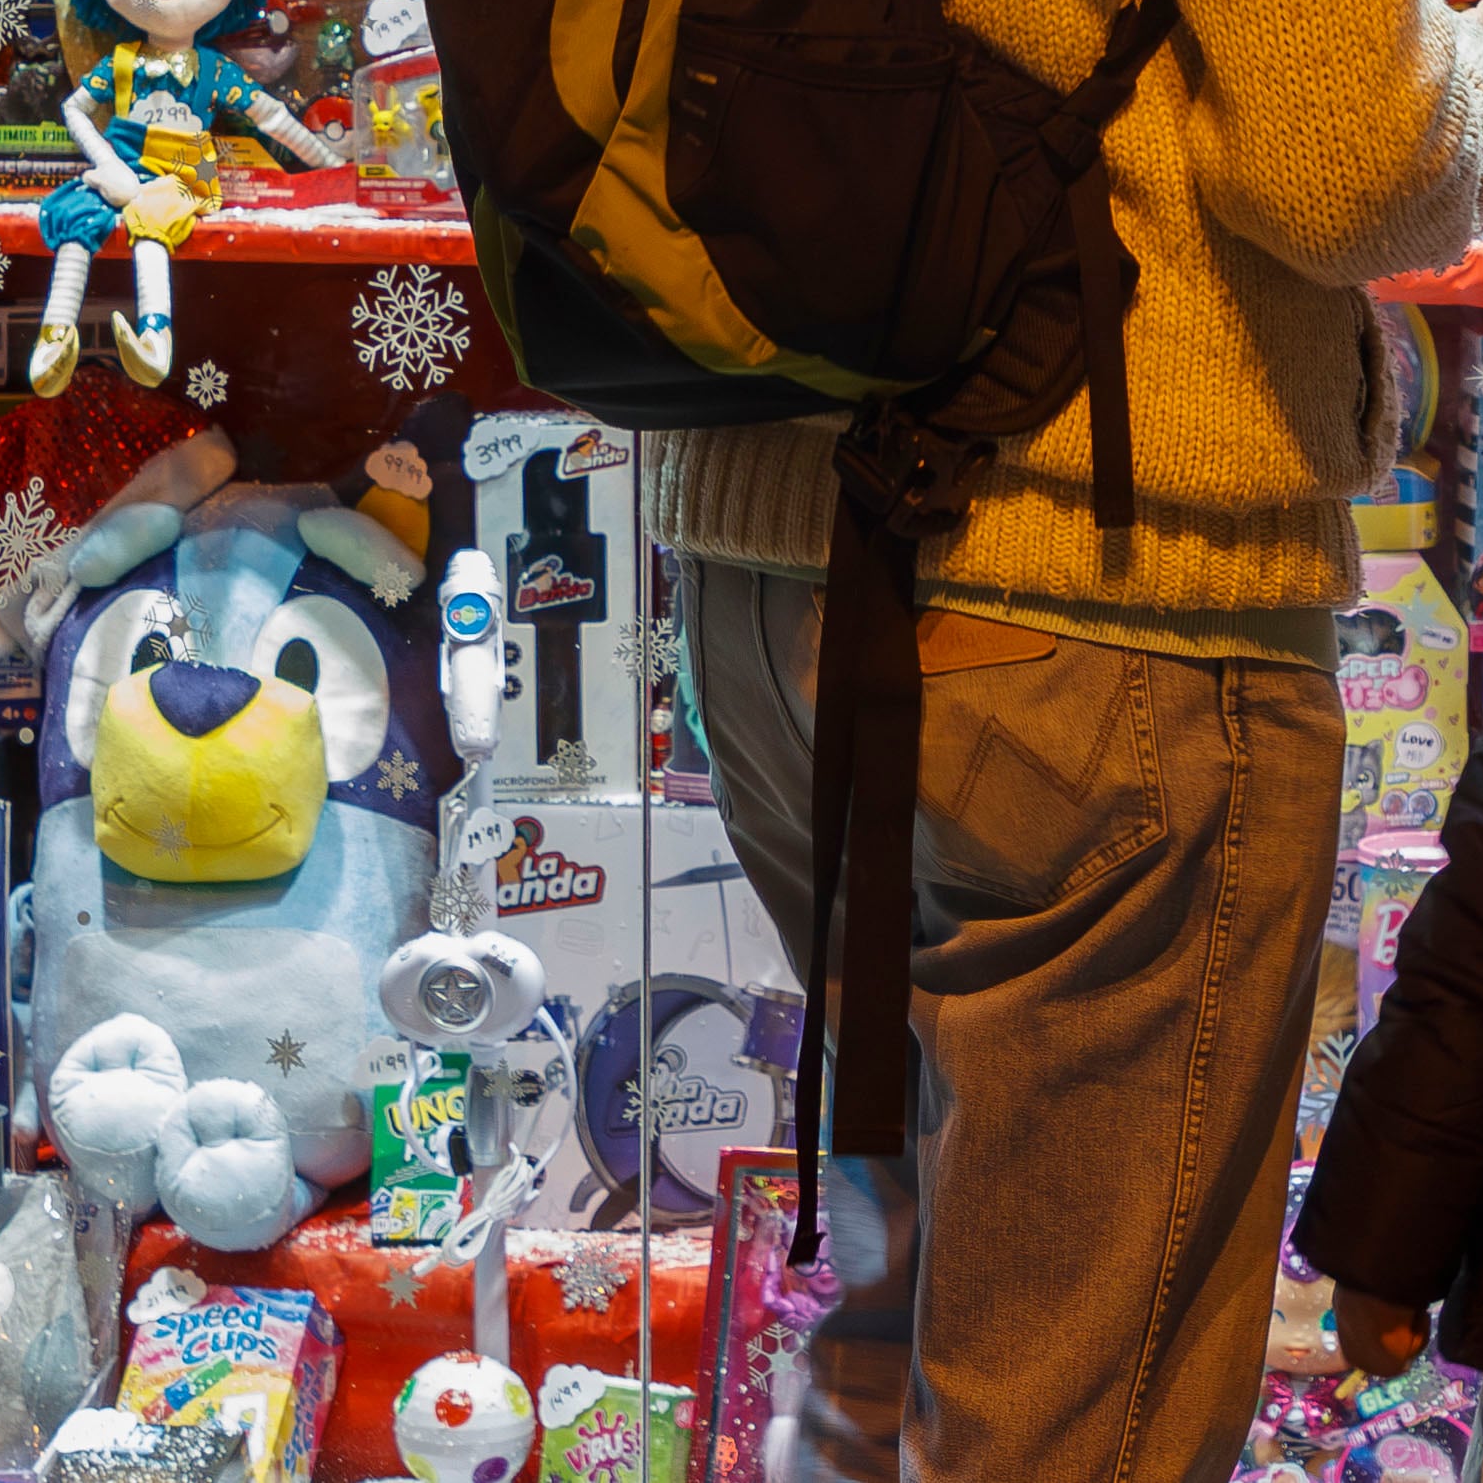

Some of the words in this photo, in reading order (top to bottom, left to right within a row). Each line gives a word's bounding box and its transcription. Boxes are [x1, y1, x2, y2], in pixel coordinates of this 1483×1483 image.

[143, 107, 189, 125] 22'99
[474, 434, 524, 465] 39'99
[1401, 731, 1436, 747] Love
[521, 854, 560, 880] La
[496, 869, 599, 909] anda
[370, 1053, 408, 1074] 11'99
[384, 1086, 466, 1139] UNO
[152, 1302, 265, 1345] Speed
[181, 1331, 278, 1365] Cups
